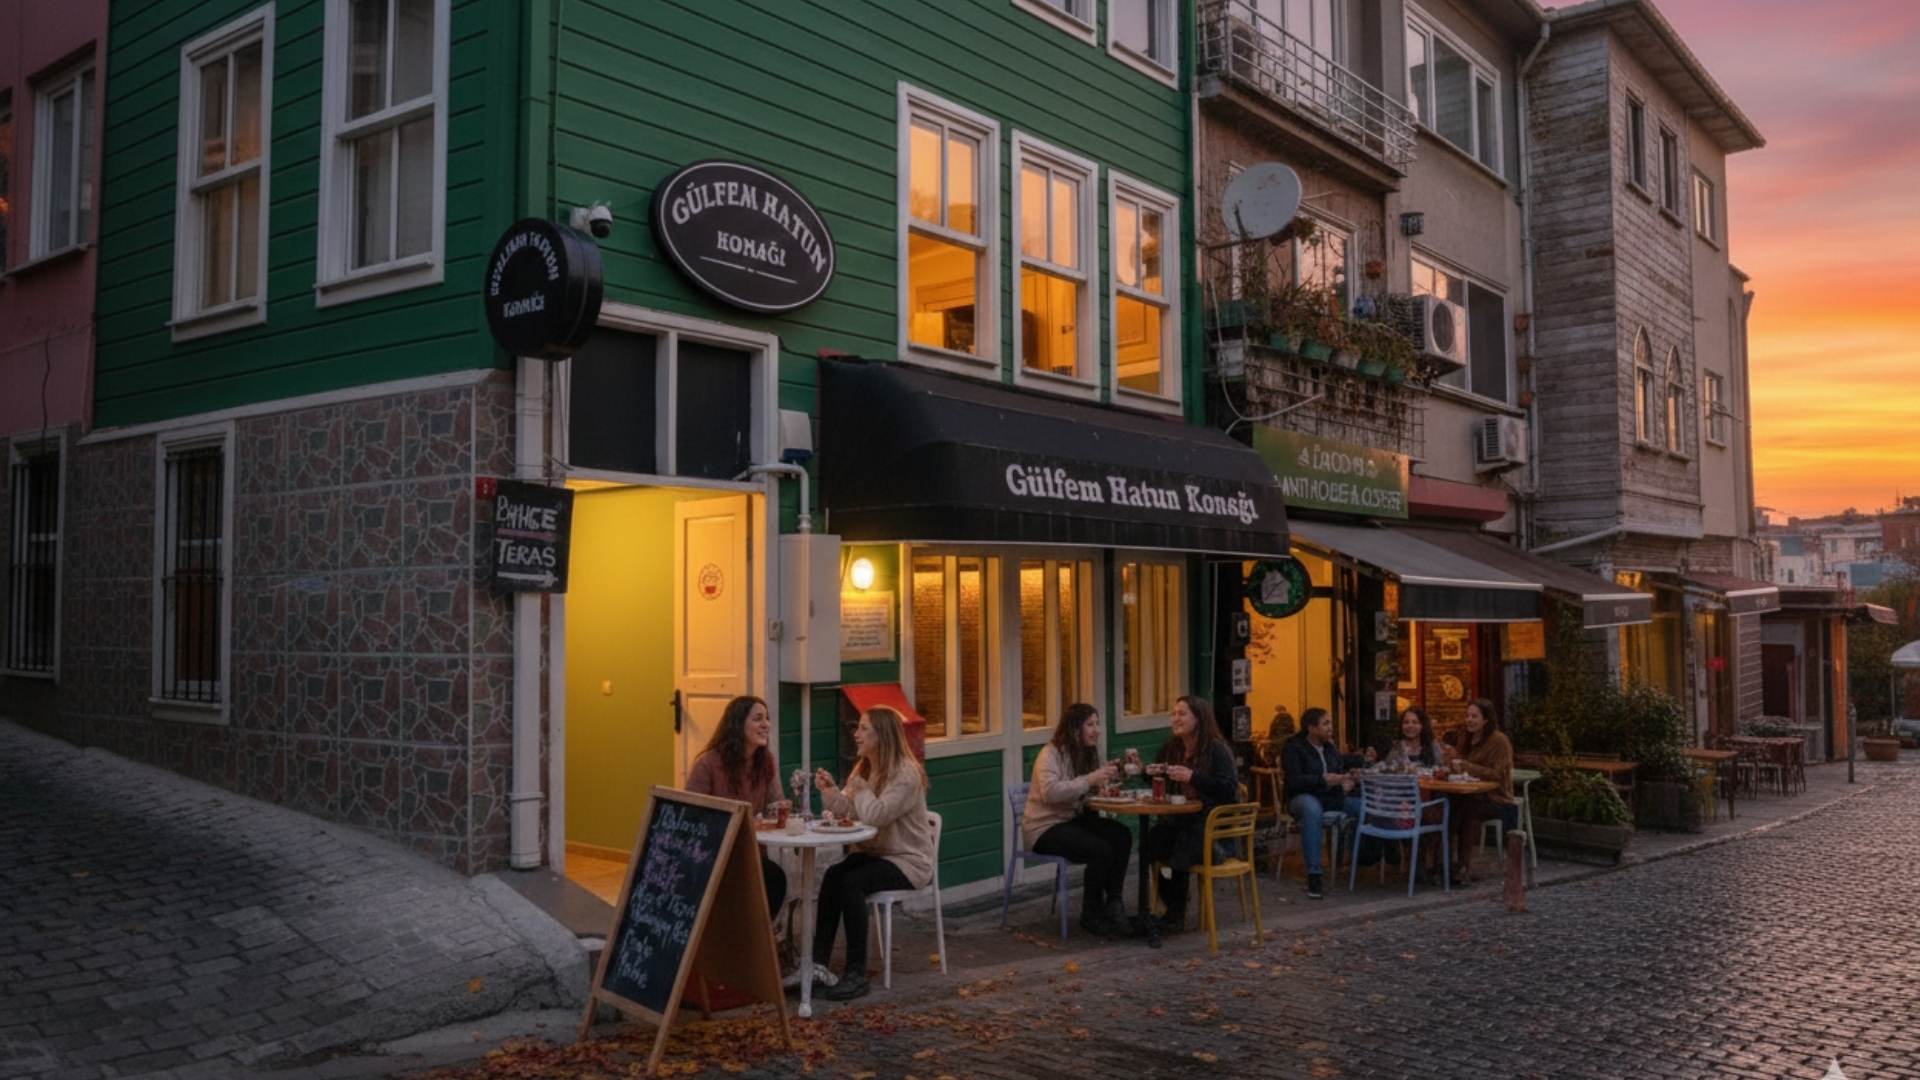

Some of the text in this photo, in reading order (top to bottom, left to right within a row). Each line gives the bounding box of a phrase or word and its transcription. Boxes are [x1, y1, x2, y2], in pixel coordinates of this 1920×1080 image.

[672, 182, 759, 225] GÜLFEM
[1005, 463, 1105, 504] Gülfem
[1106, 475, 1181, 511] Hatun
[495, 538, 557, 568] TERAS
